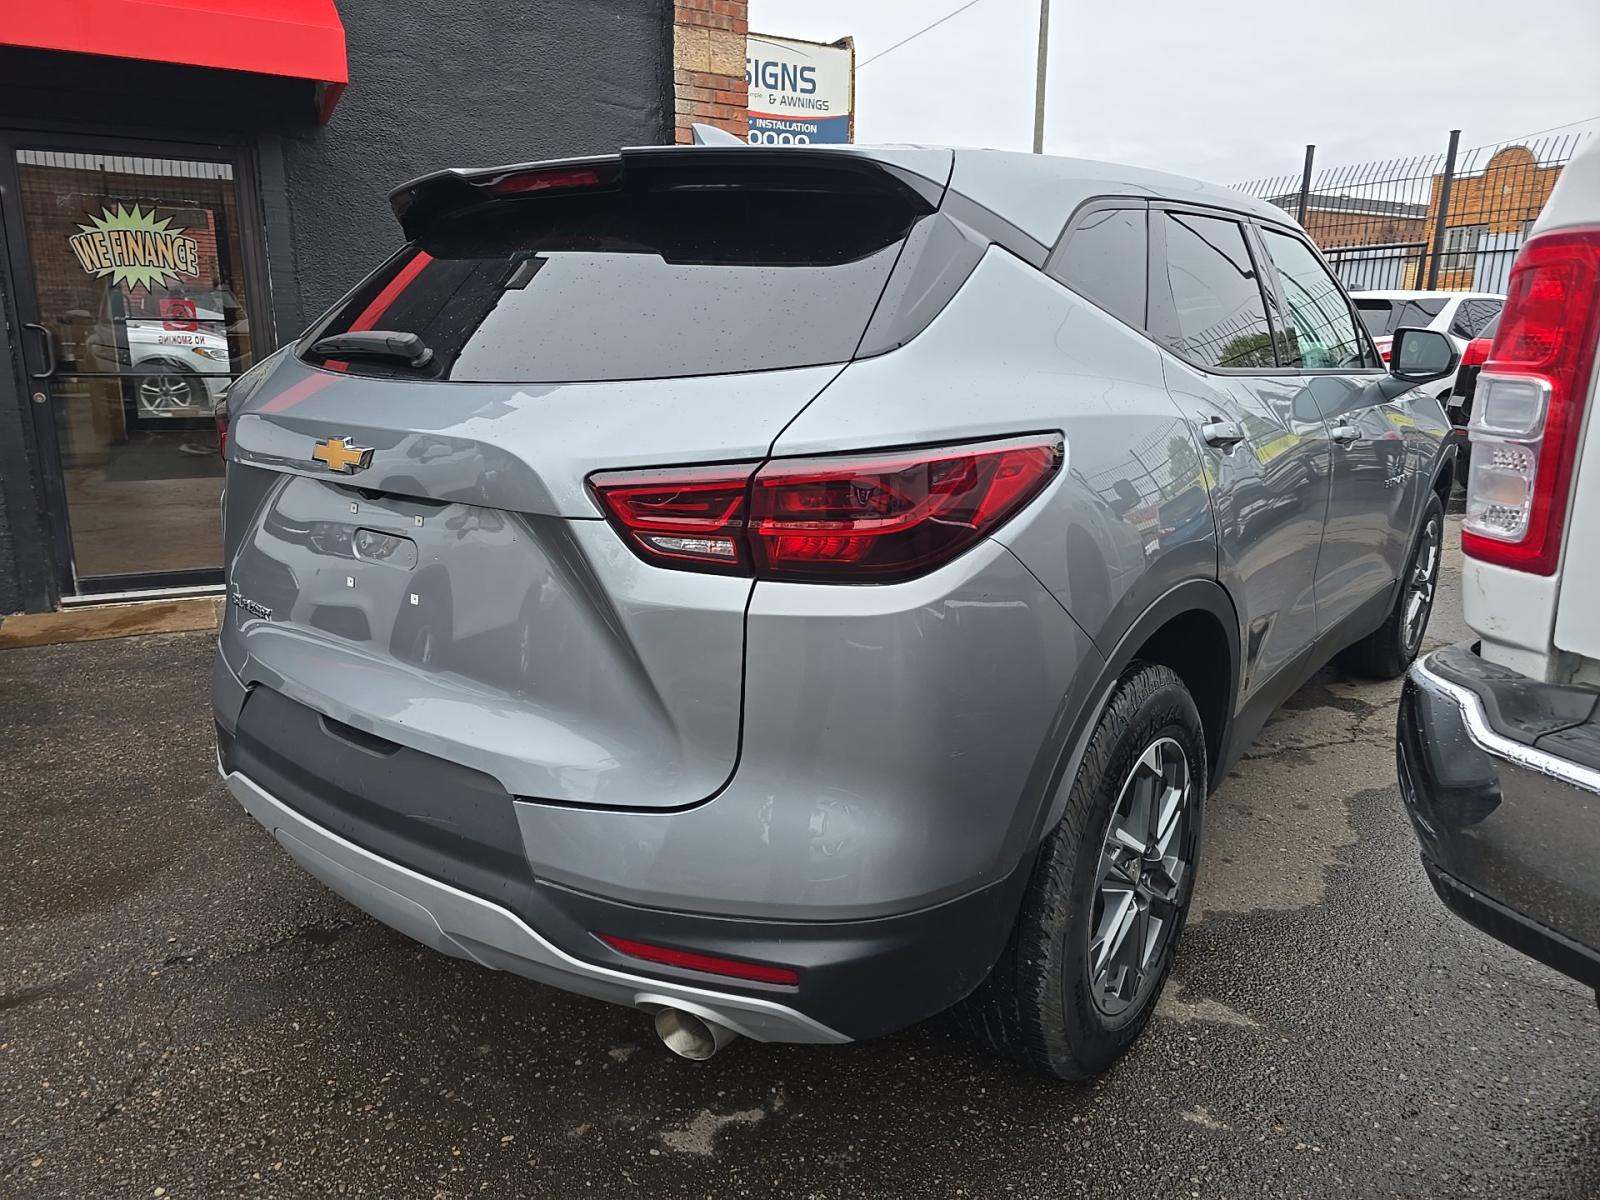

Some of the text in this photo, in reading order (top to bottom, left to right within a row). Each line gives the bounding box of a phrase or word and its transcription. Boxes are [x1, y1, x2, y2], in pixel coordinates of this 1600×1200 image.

[769, 94, 829, 111] & AWNINGS
[756, 119, 818, 133] INSTALLATION
[71, 230, 198, 276] WE FINANCE
